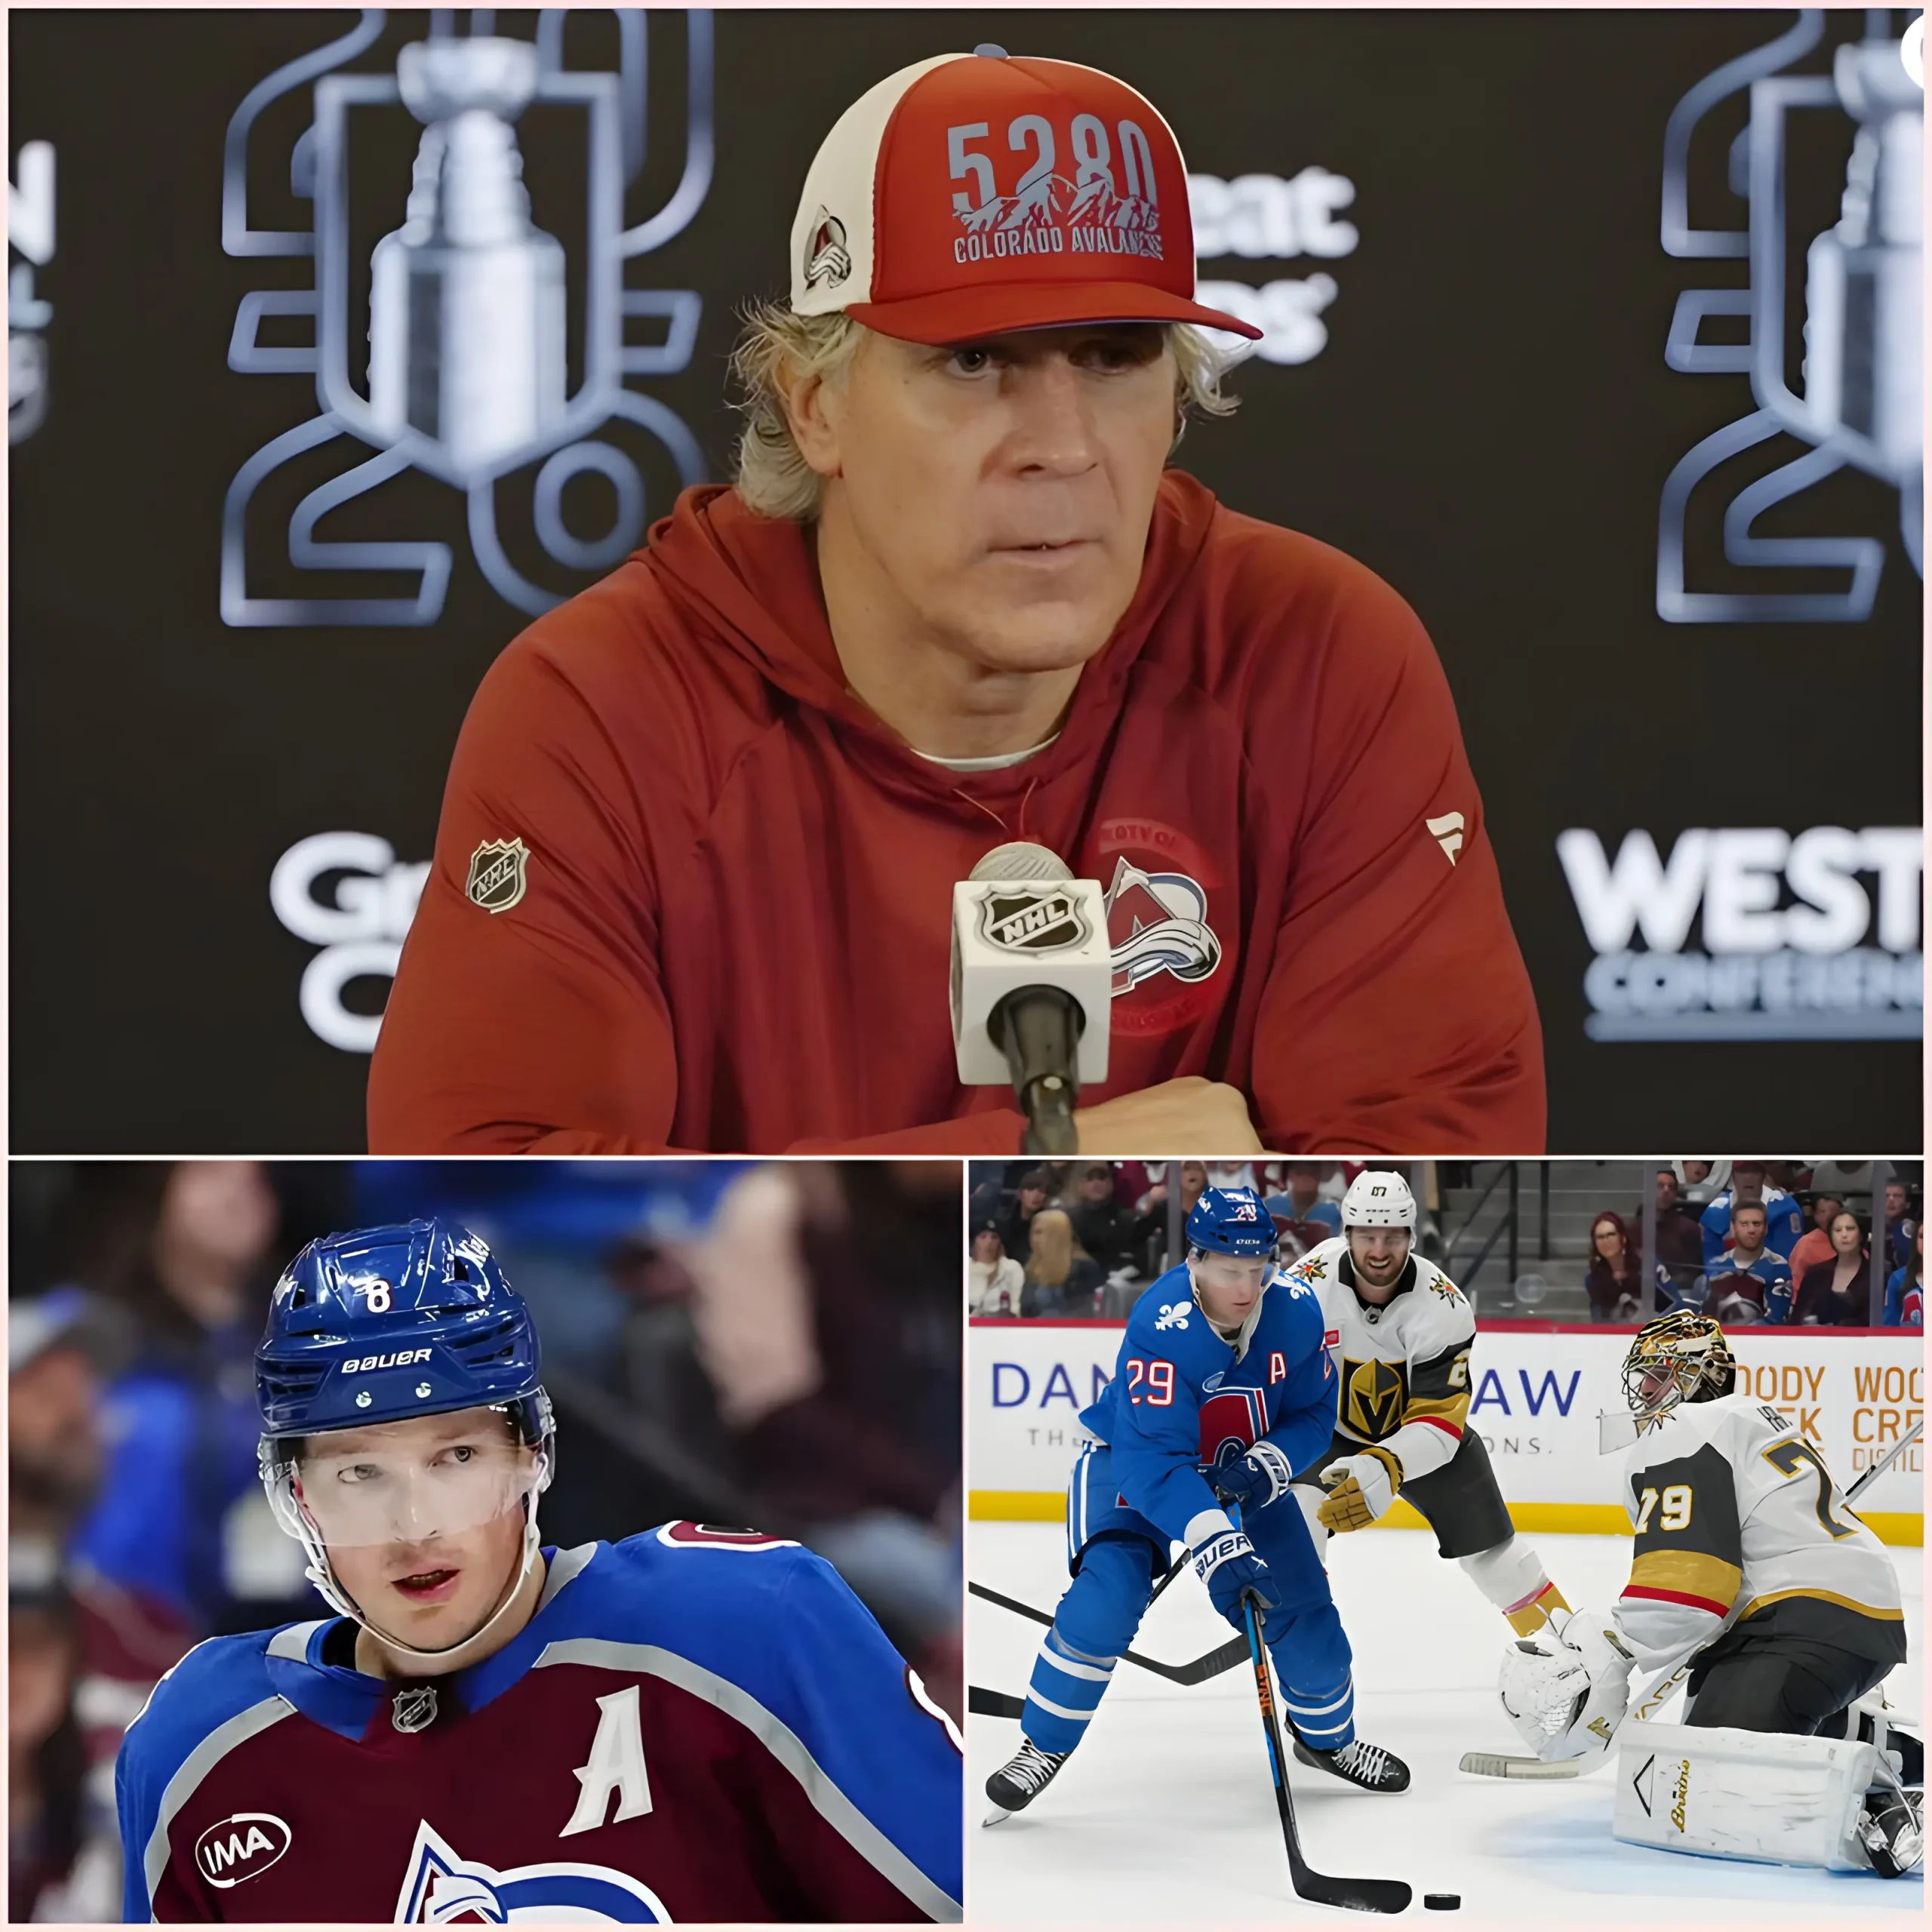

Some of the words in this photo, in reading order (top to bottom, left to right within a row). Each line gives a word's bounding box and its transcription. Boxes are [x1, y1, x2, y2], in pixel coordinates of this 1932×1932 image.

[947, 113, 1158, 216] 5280
[954, 226, 1063, 264] COLORADO
[1001, 901, 1069, 944] NHL
[366, 1280, 391, 1313] 8
[1126, 1358, 1176, 1407] 29
[1268, 1352, 1287, 1386] A
[559, 1685, 652, 1837] A
[204, 1826, 274, 1874] IMA
